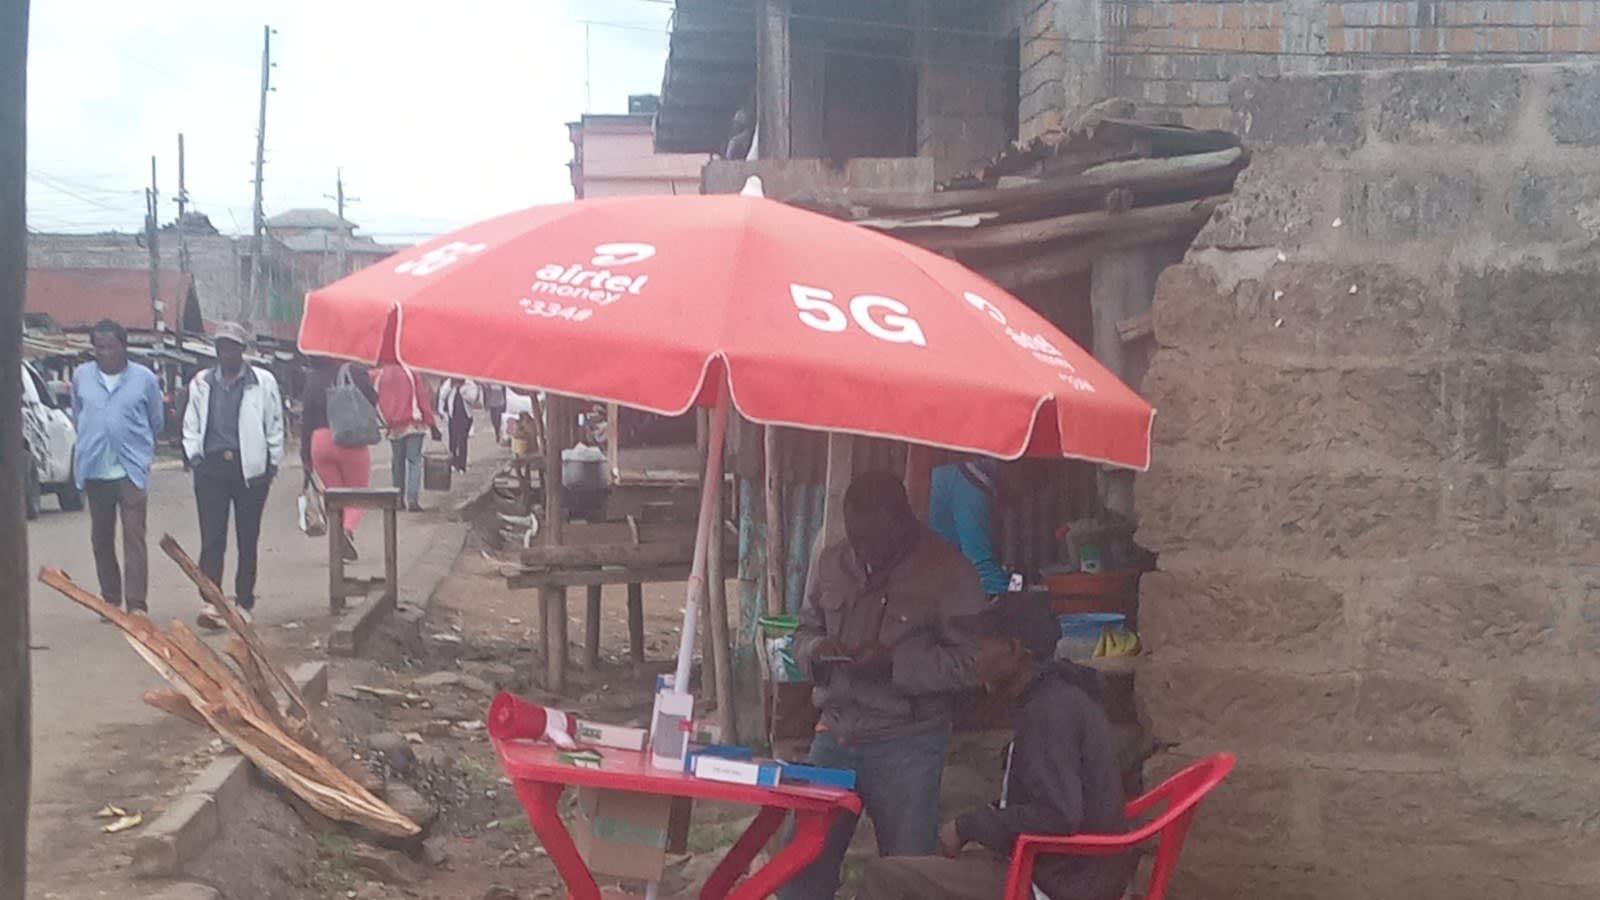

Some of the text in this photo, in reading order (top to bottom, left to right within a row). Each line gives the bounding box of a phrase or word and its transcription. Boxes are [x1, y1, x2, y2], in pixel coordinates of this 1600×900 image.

[531, 281, 621, 306] money
[535, 263, 648, 295] airtel
[789, 283, 927, 346] 5G
